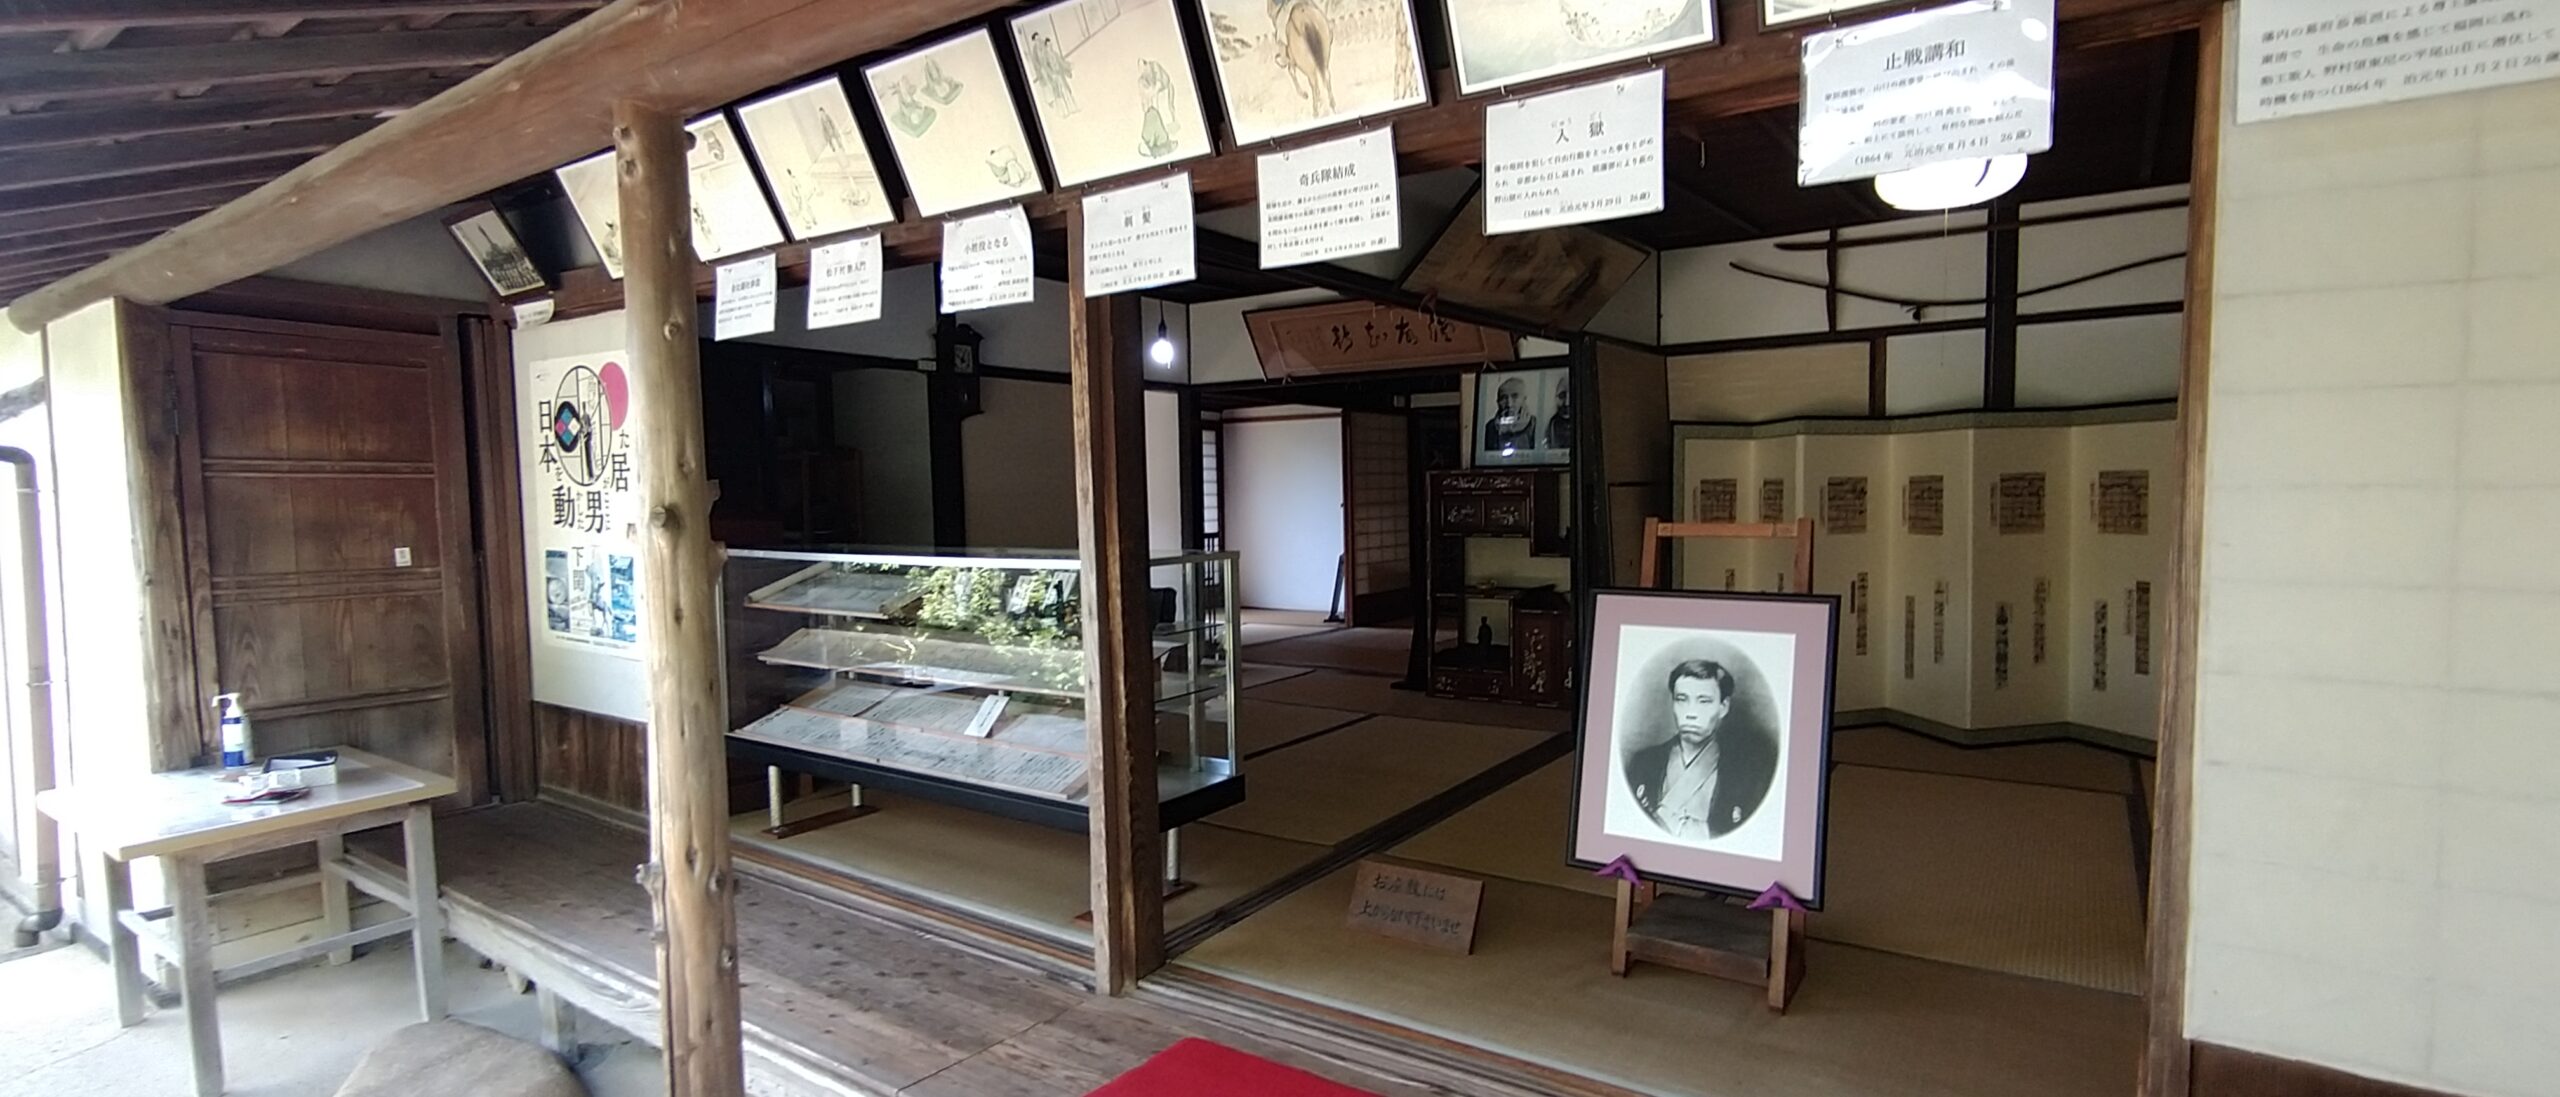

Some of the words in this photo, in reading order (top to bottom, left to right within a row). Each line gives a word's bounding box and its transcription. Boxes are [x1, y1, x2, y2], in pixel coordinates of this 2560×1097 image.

[1883, 39, 1966, 72] 止戦講和
[1299, 163, 1356, 187] 奇兵隊結成
[964, 236, 1009, 255] 小姓役となる
